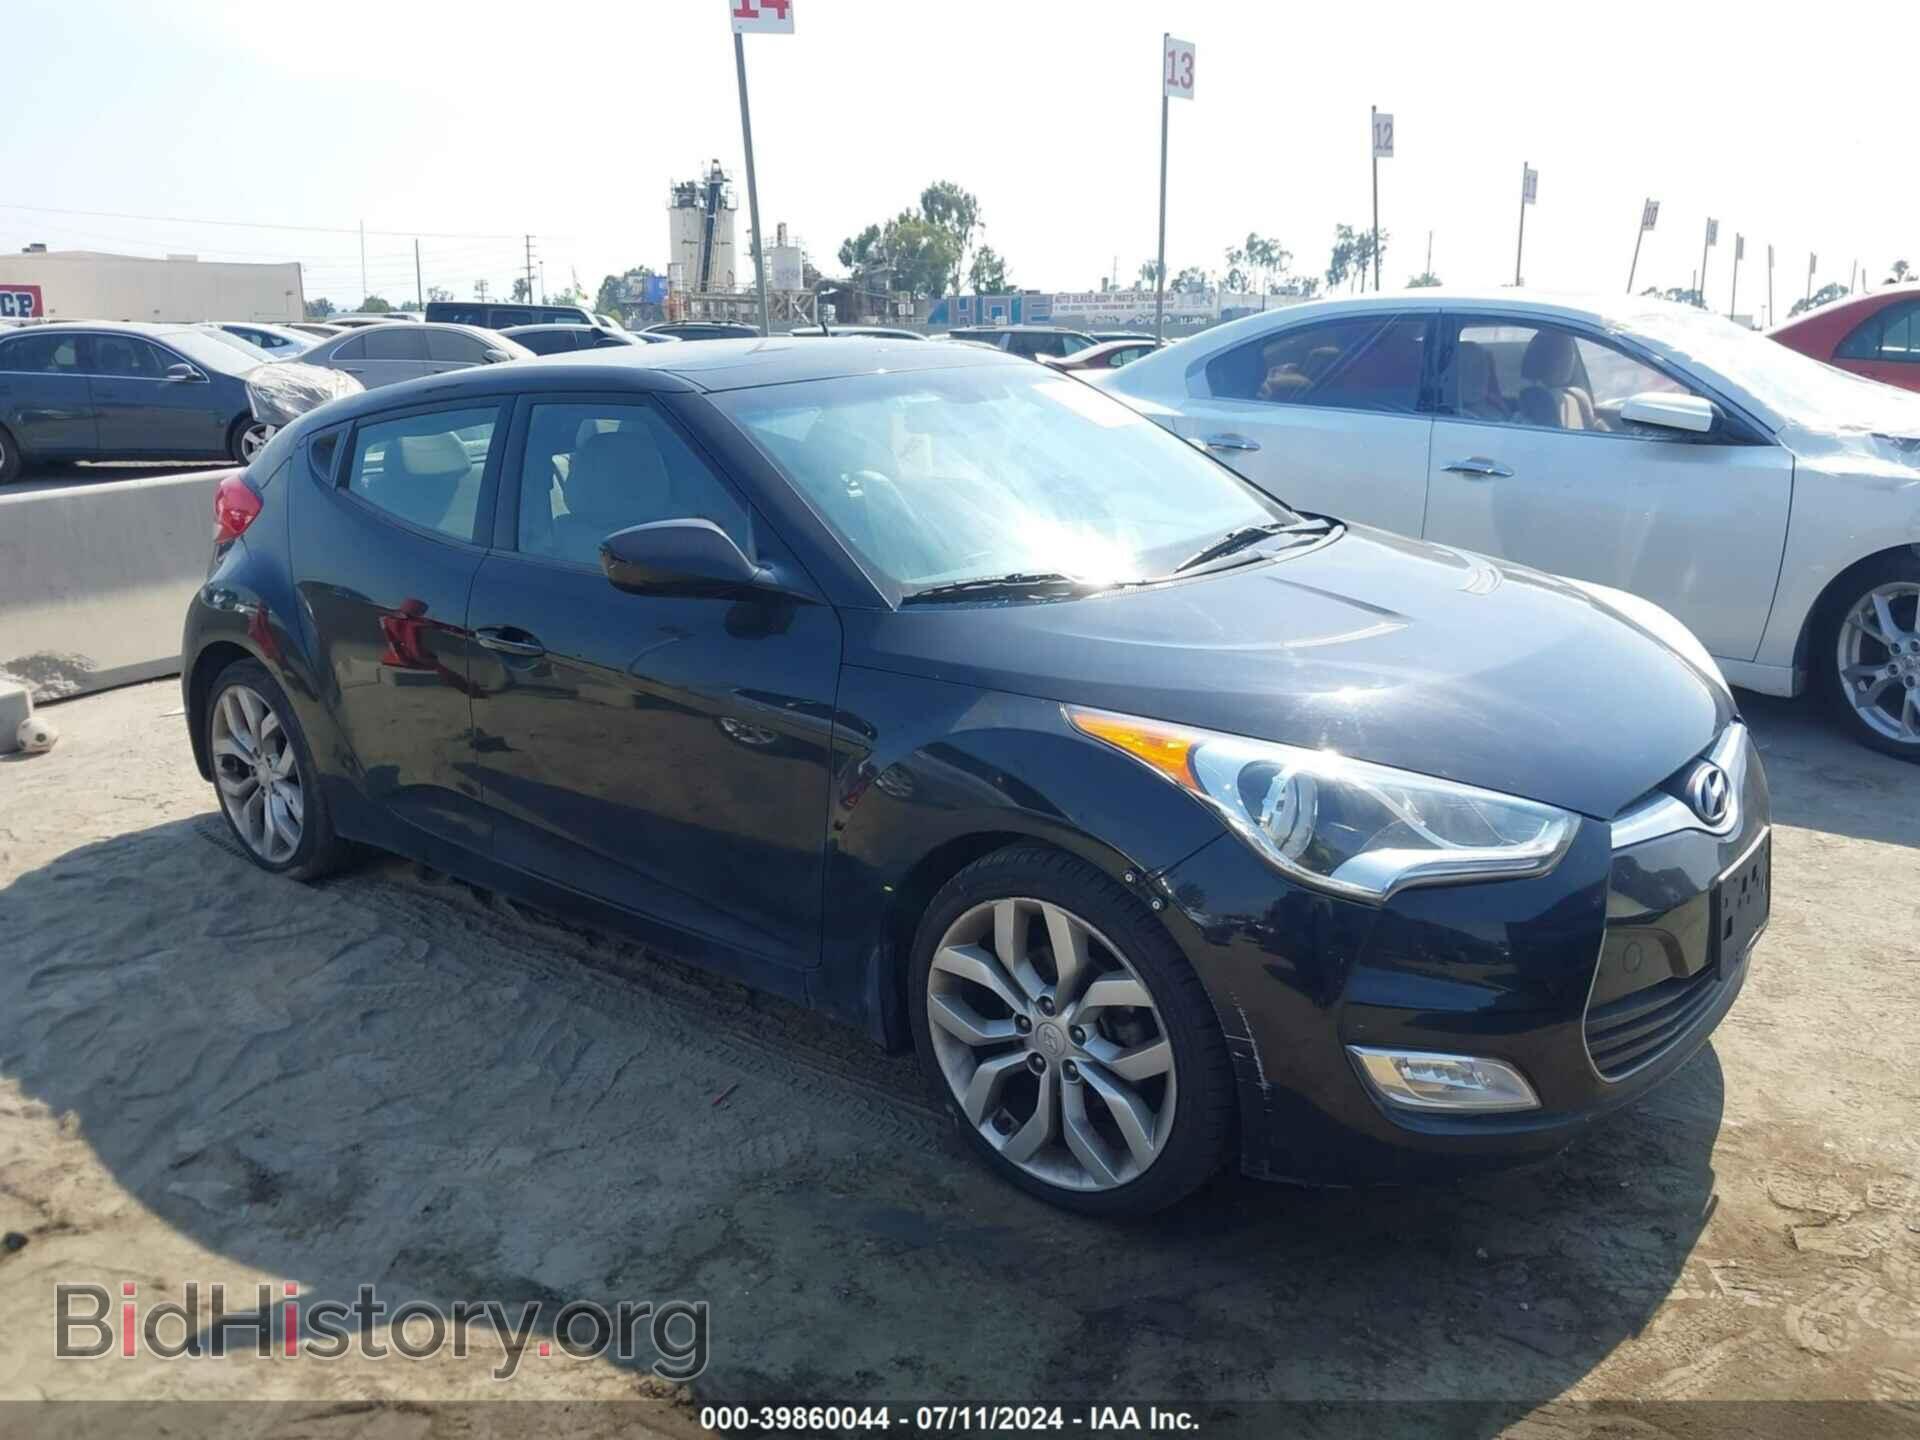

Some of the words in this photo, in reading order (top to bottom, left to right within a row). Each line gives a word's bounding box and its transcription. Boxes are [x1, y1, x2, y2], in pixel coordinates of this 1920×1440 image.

[1167, 49, 1194, 90] 13
[1374, 122, 1394, 151] 12
[1643, 207, 1659, 226] 10
